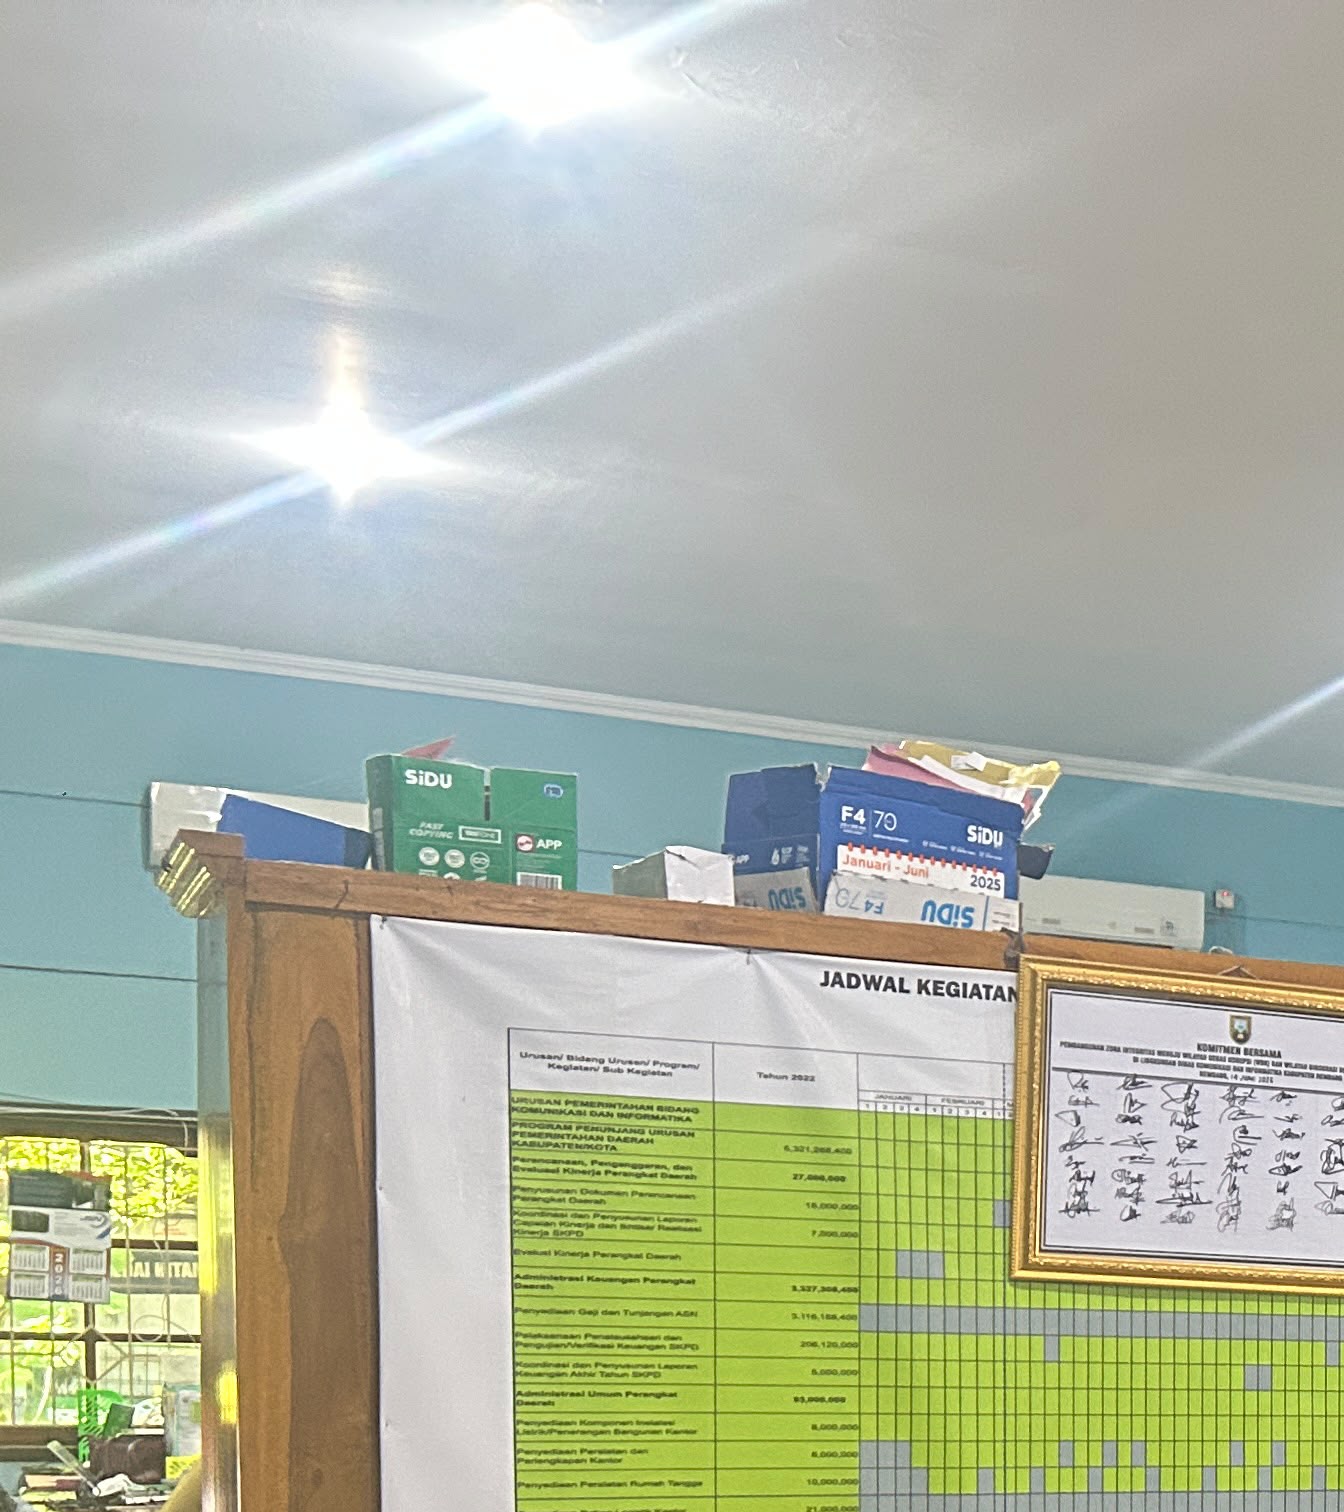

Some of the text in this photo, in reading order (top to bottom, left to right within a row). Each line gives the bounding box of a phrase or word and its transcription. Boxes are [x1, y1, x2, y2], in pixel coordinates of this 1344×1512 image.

[405, 769, 452, 788] SiDU
[841, 805, 866, 823] F4
[967, 824, 1003, 845] SiDU
[536, 839, 562, 850] APP
[842, 856, 891, 873] Januari
[903, 863, 929, 879] Juni
[970, 875, 1001, 891] 2025
[921, 900, 976, 928] SiDU
[820, 970, 1019, 1002] JADWAL KEGIATAN
[566, 1054, 605, 1064] Bidang
[1196, 1043, 1282, 1059] KOMITMEN BERSAMA
[757, 1072, 789, 1081] Tahun
